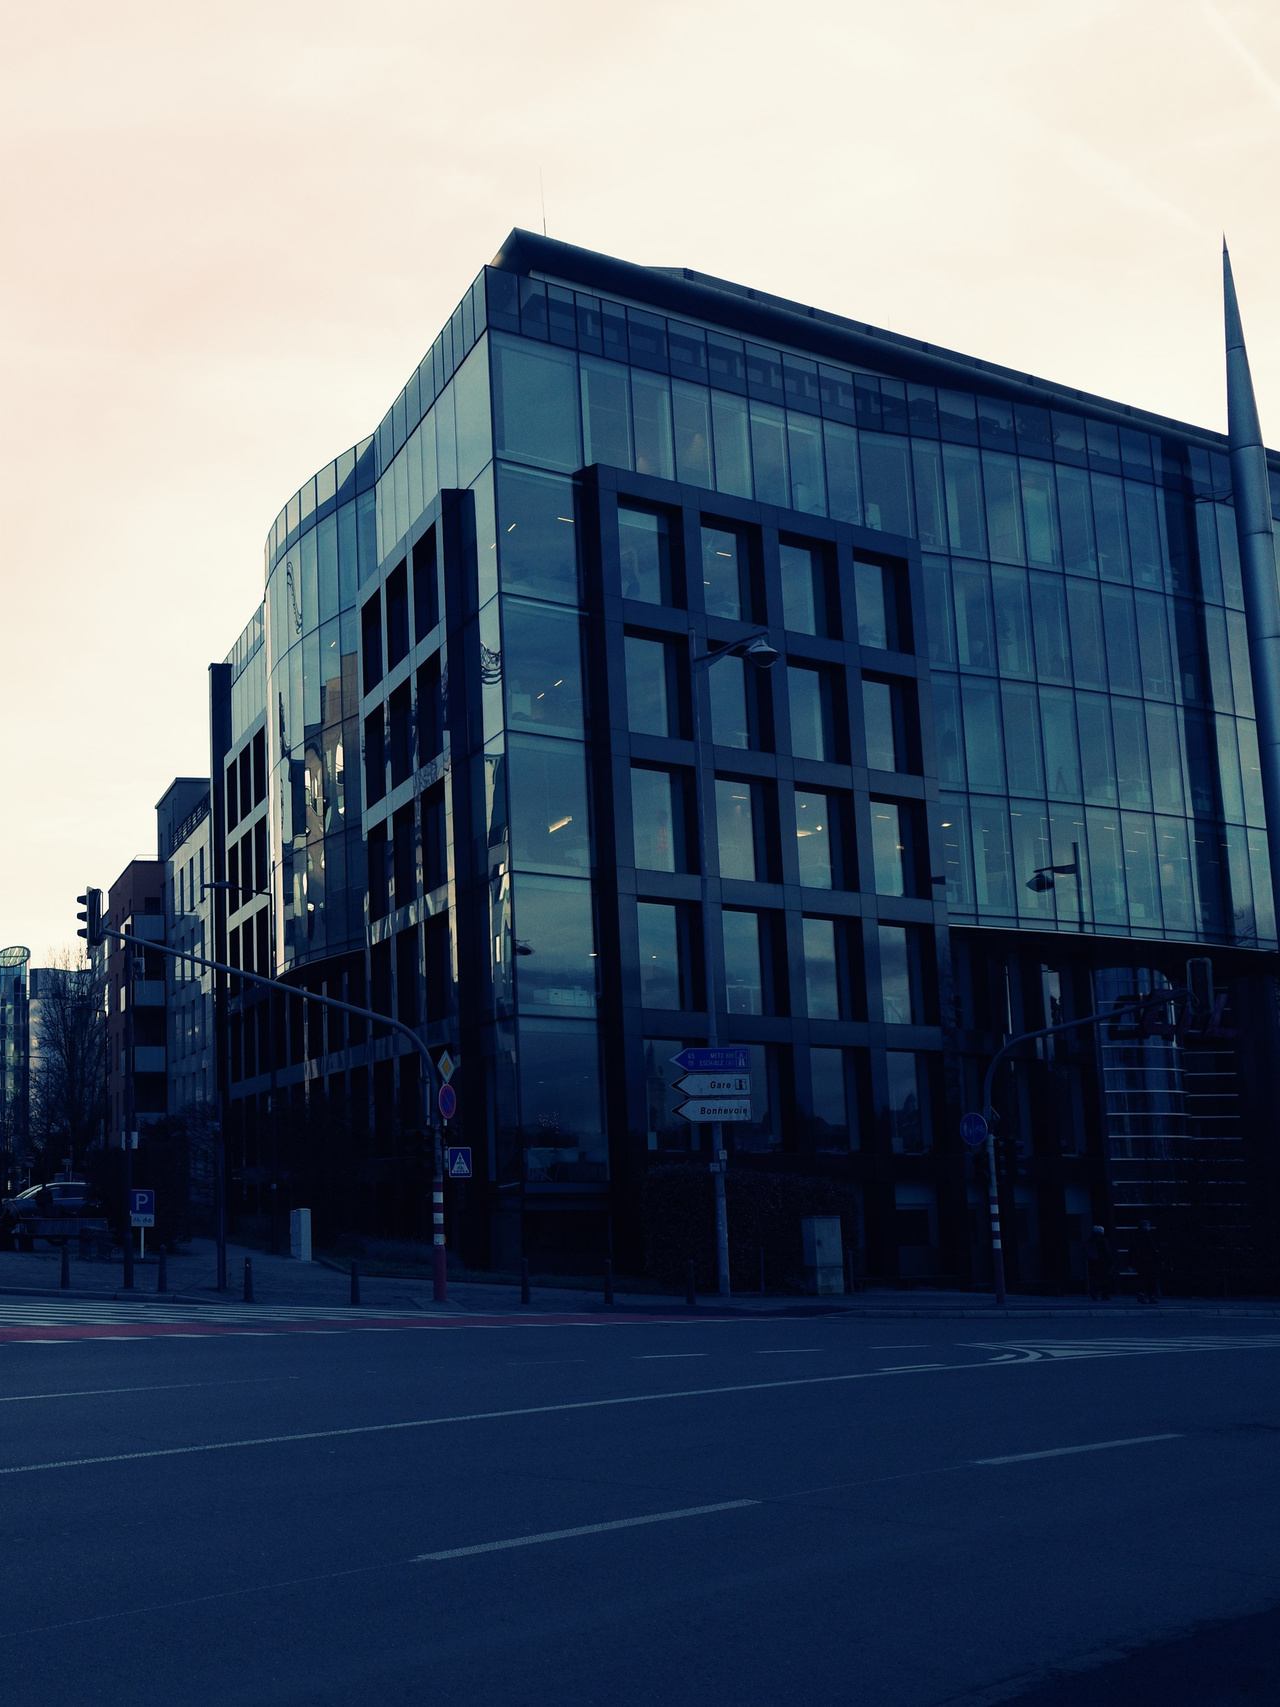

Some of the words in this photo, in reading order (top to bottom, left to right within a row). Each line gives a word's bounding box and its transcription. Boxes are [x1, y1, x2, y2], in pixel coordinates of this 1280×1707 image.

[710, 1081, 731, 1089] Gare
[700, 1107, 748, 1115] Bonnevoie
[136, 1193, 149, 1211] P
